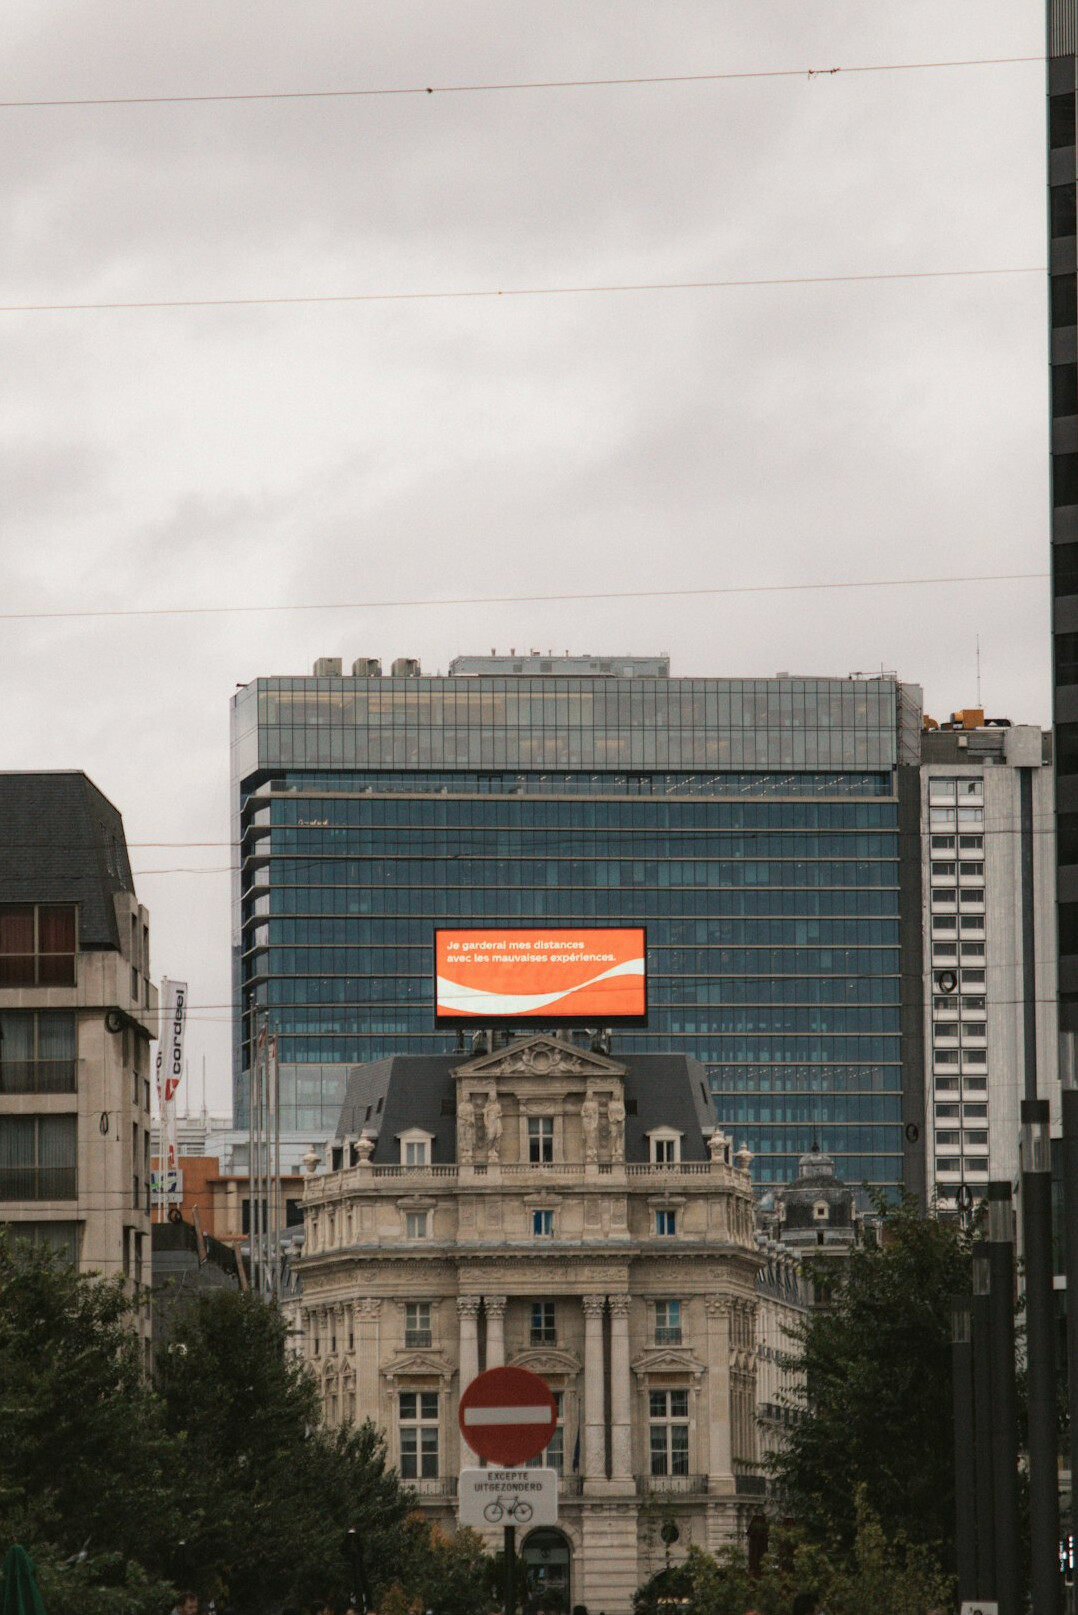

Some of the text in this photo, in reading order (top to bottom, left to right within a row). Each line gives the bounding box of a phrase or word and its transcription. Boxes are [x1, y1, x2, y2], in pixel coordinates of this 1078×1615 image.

[447, 941, 585, 952] Je garderai mes distances
[447, 953, 617, 964] avec les mauvaises expériences.
[173, 989, 184, 1075] cordeel
[474, 1483, 543, 1492] UITGEZONDERD
